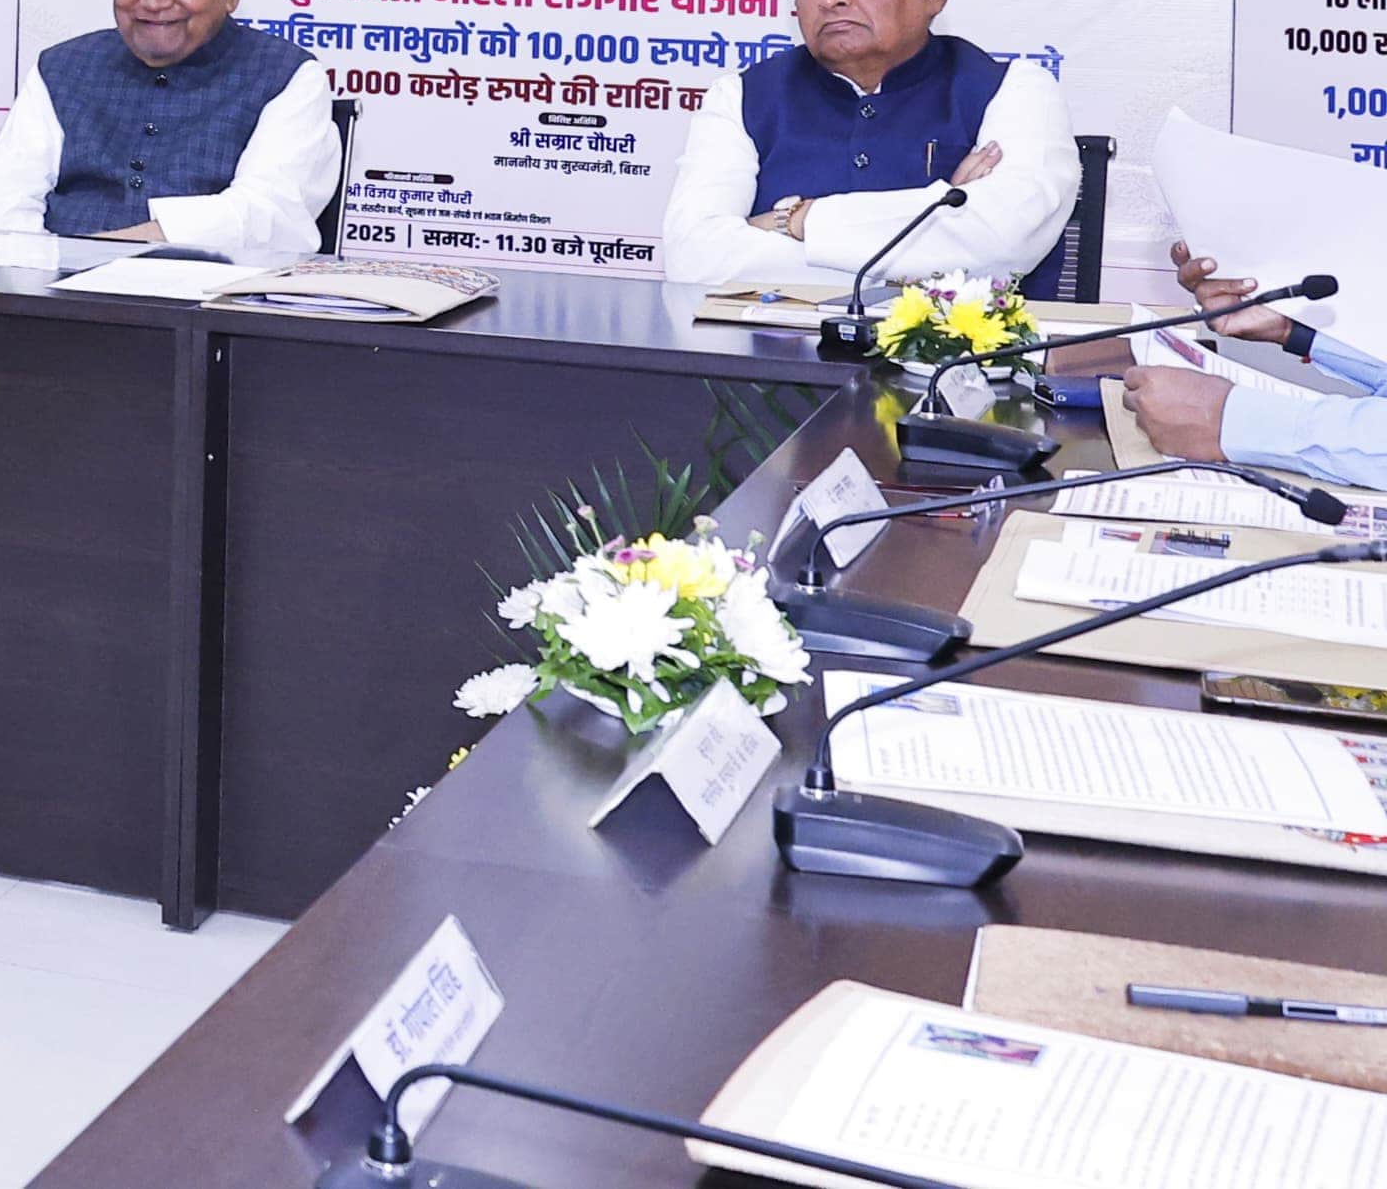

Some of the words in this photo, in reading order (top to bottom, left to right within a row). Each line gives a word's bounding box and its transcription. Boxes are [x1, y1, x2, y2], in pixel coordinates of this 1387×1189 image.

[361, 20, 475, 63] लाभुकों
[477, 23, 520, 58] को
[527, 32, 639, 65] 10,000
[648, 32, 729, 67] रुपये
[1285, 28, 1367, 55] 10,000
[326, 69, 400, 96] 1,000
[408, 68, 481, 106] करोड़
[485, 73, 555, 103] रुपये
[560, 73, 599, 107] की
[603, 78, 672, 110] राशि
[679, 85, 710, 111] क
[1323, 85, 1387, 119] 1,00
[510, 128, 531, 147] श्री
[534, 133, 583, 150] सम्राट
[587, 132, 636, 153] चौधरी
[494, 155, 541, 168] माननीय
[543, 159, 558, 170] उप
[560, 160, 616, 175] मुख्यमंत्री,
[619, 161, 650, 176] बिहार
[346, 183, 361, 199] श्री
[364, 184, 397, 199] विजय
[399, 190, 434, 204] कुमार
[437, 189, 472, 204] चौधरी
[347, 224, 395, 242] 2025
[496, 234, 546, 253] 11.30
[551, 235, 585, 256] बजे
